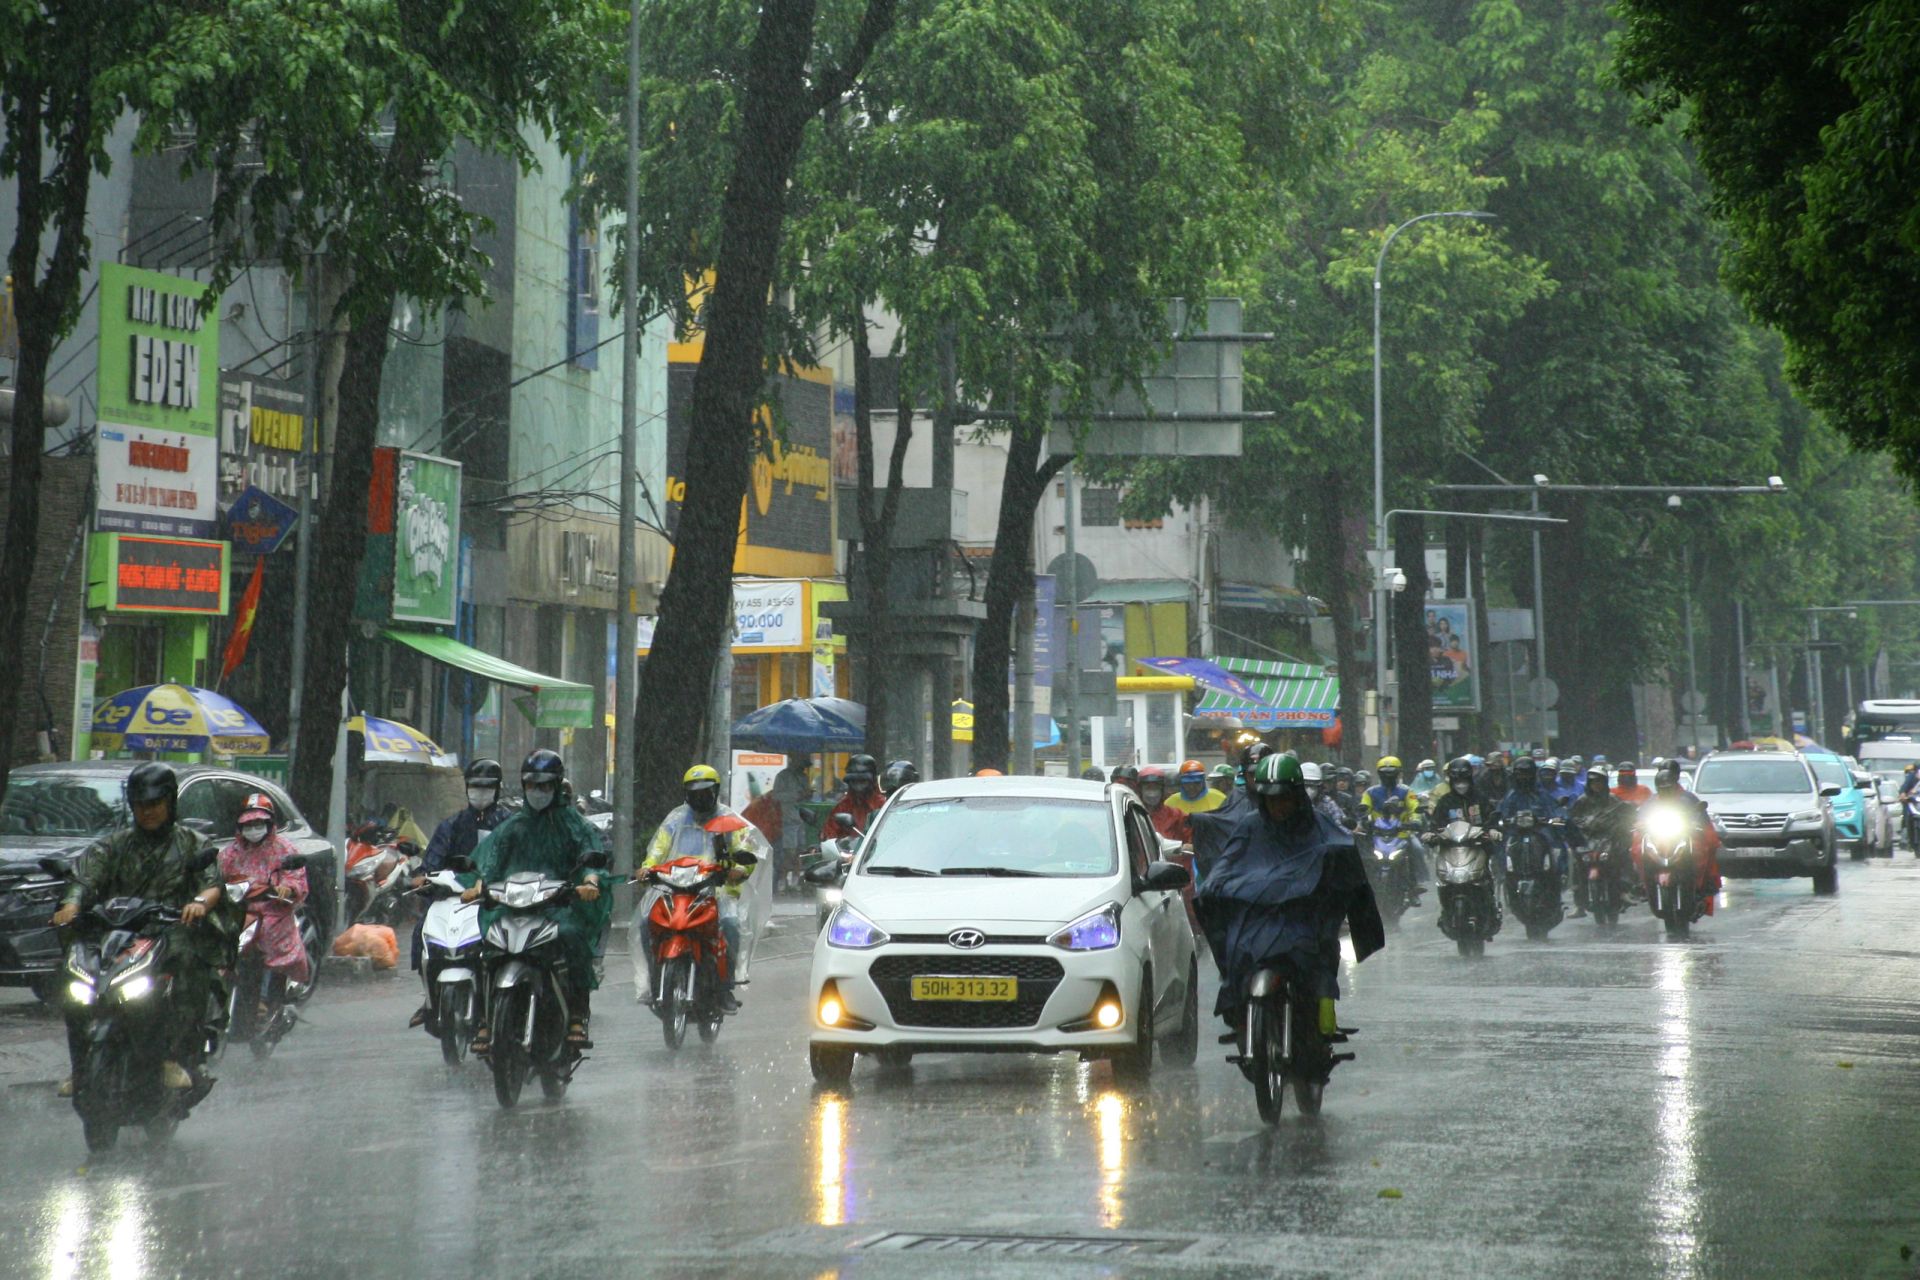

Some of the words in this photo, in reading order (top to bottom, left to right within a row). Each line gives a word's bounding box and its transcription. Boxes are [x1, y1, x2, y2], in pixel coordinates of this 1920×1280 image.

[134, 334, 199, 409] EDEN
[735, 613, 783, 629] 90.000
[145, 701, 193, 726] be
[201, 703, 246, 728] be
[171, 739, 188, 749] XE
[369, 731, 413, 752] be
[921, 981, 1009, 996] 50H-313.32
